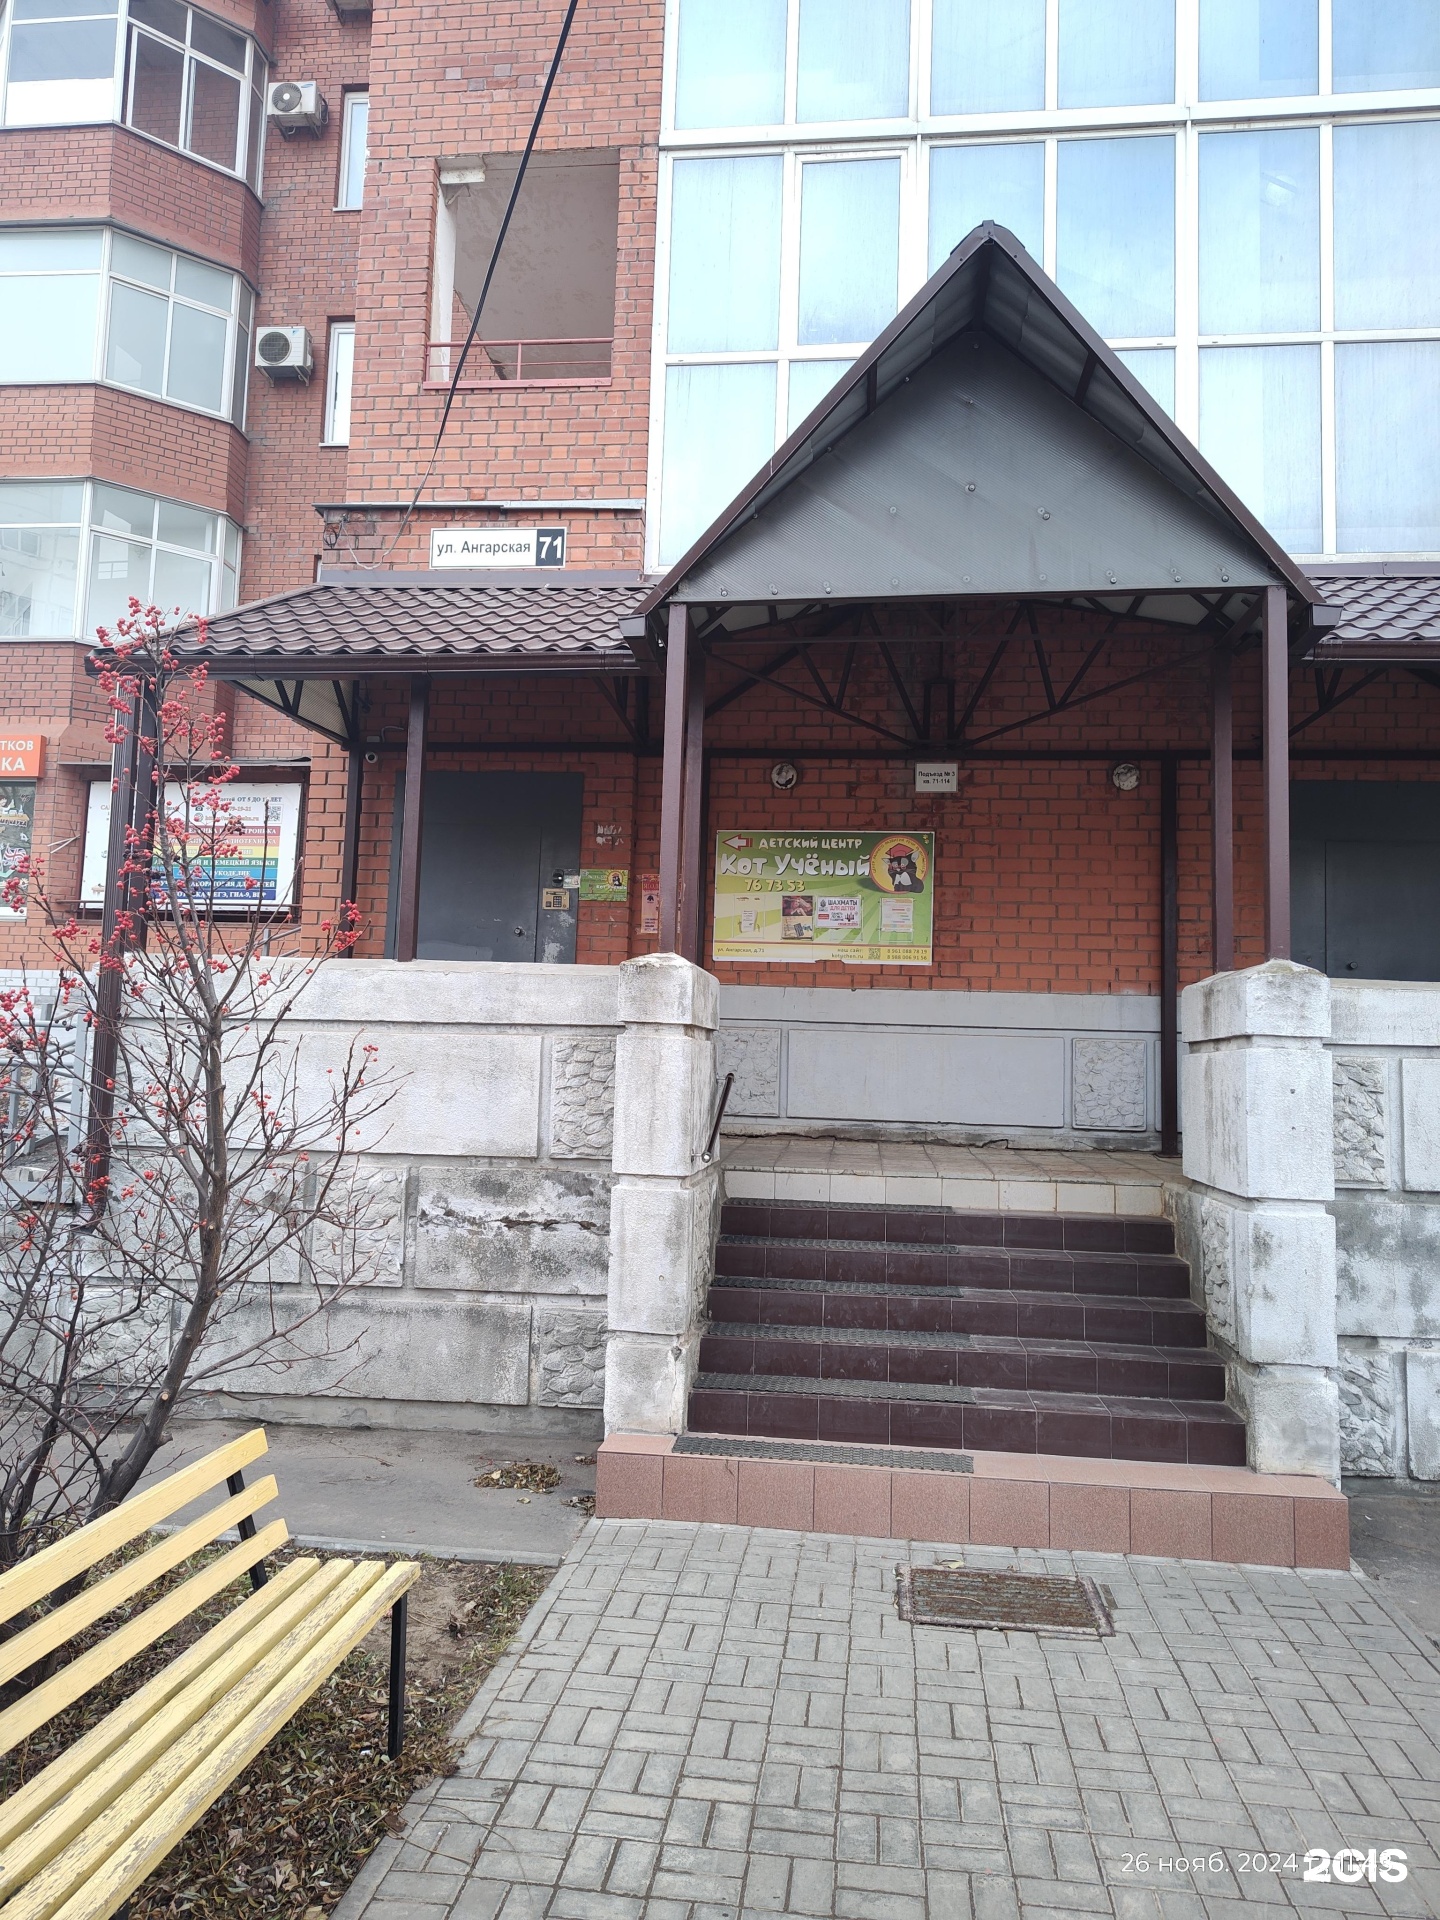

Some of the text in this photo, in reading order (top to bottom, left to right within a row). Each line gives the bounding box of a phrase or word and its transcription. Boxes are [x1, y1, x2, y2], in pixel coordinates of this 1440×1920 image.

[437, 536, 562, 561] ул. Ангарская 71
[758, 836, 863, 850] ДЕТСКИЙ ЦЕНТР
[720, 853, 768, 876] Кот
[774, 853, 871, 877] Учёный
[744, 879, 806, 892] 76 73 53
